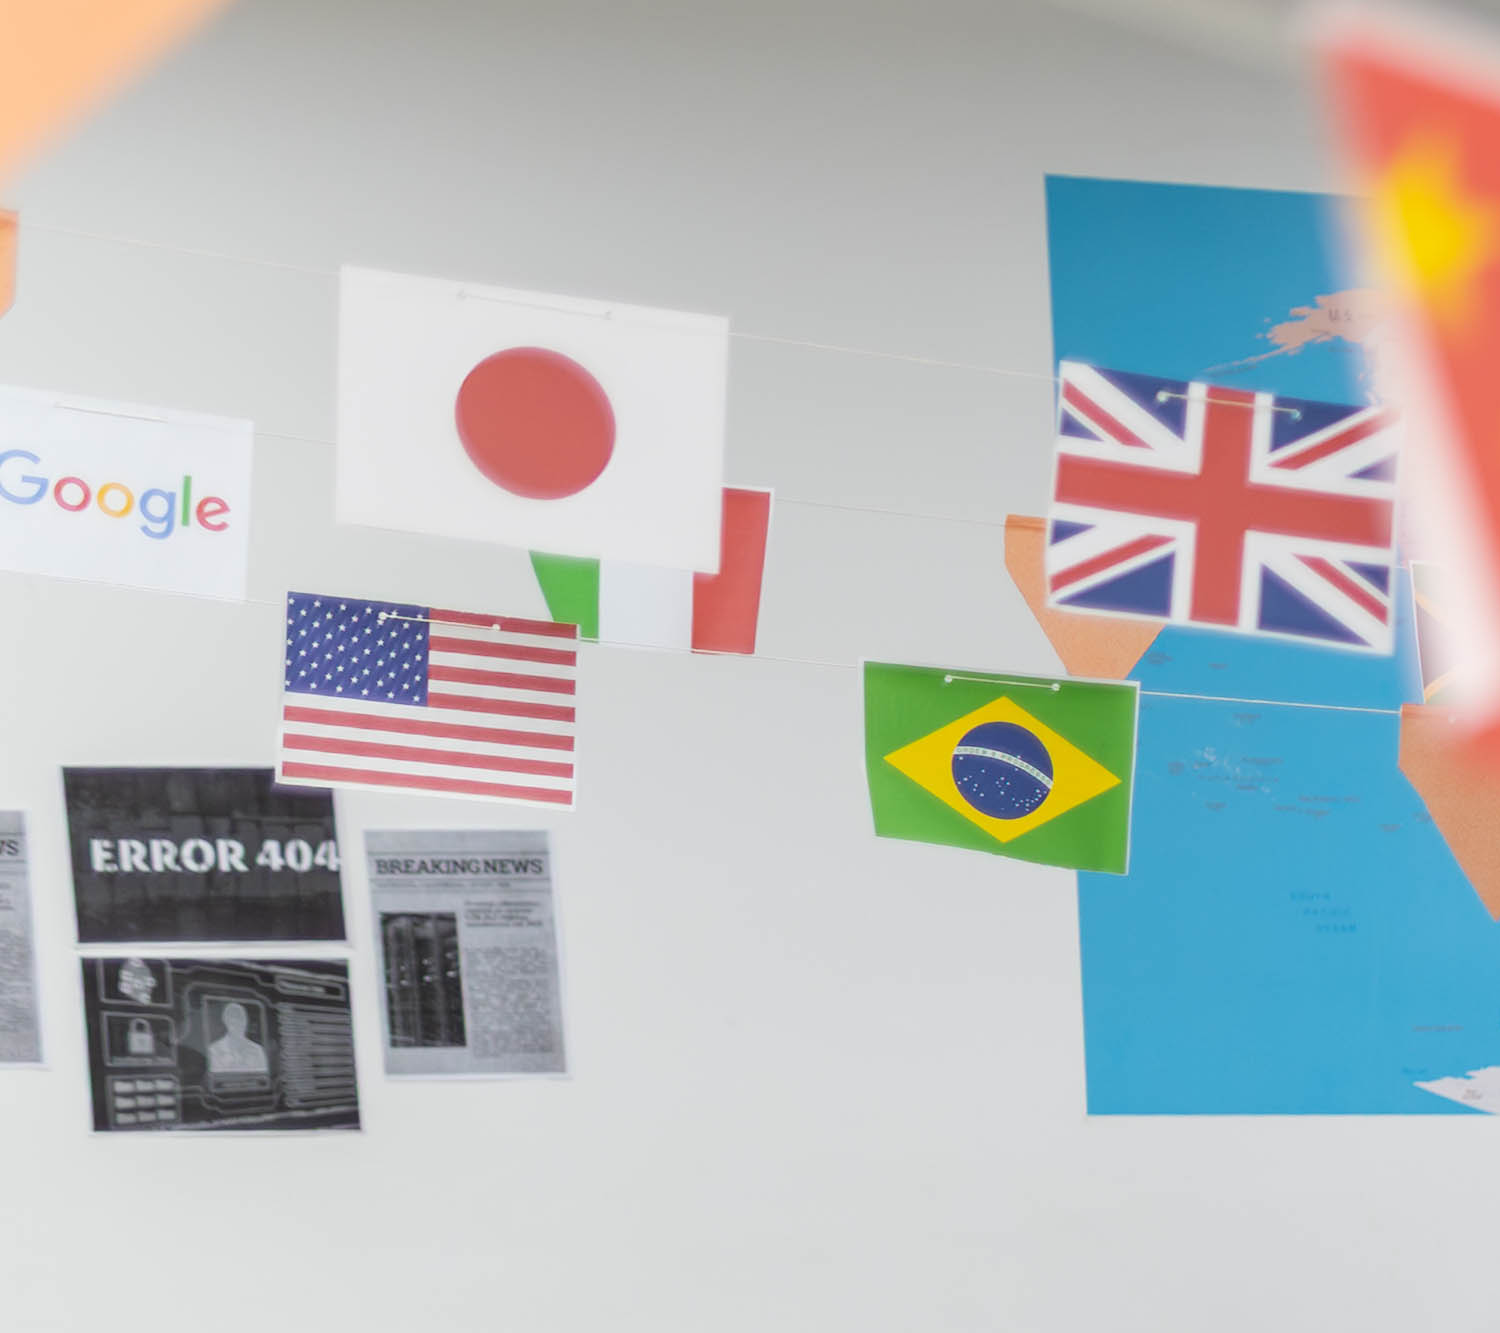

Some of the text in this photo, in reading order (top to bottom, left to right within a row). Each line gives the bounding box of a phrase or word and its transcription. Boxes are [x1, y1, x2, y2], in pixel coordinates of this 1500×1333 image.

[0, 449, 231, 540] Google
[90, 838, 341, 873] ERROR 404
[376, 859, 543, 875] BREAKING NEWS
